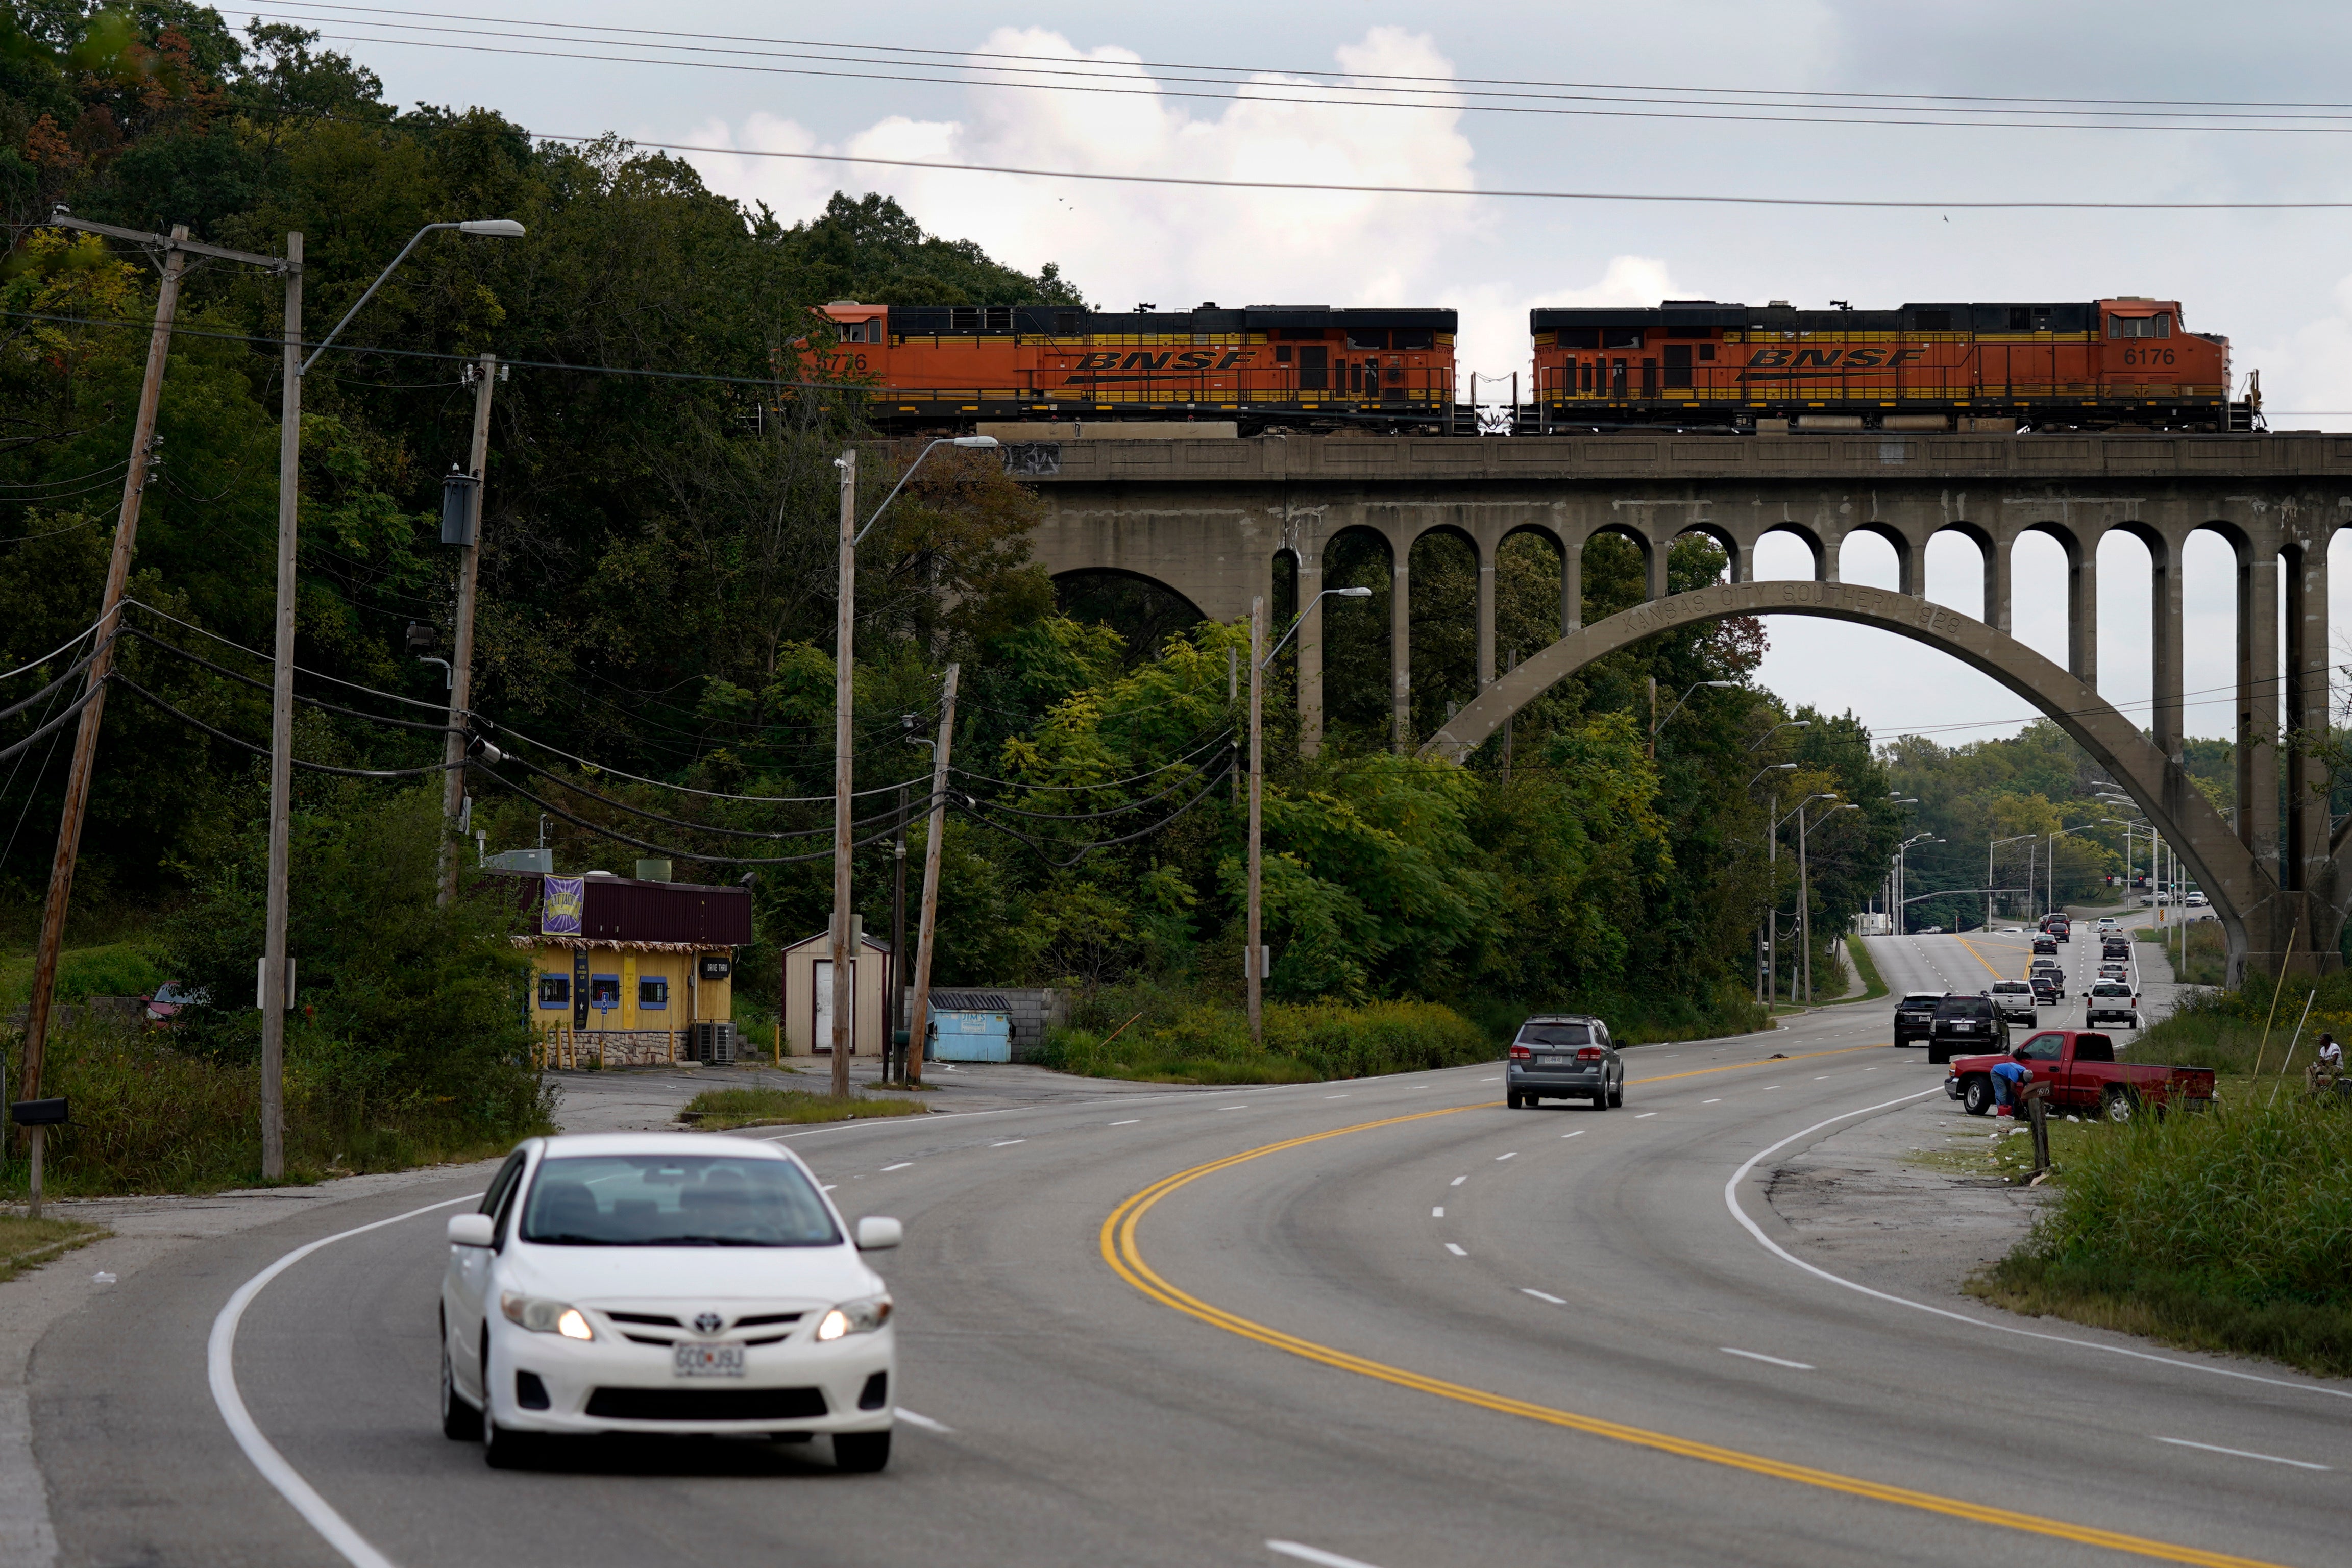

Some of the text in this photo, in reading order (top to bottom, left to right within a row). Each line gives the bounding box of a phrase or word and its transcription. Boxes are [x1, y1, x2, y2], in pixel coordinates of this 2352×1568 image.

[1437, 346, 1451, 354] 5776
[1538, 346, 1552, 355] 6176
[1746, 348, 1928, 367] BNSF
[2124, 348, 2175, 365] 6176
[1074, 351, 1258, 370] BNSF
[1622, 585, 1961, 634] KANSAS CITY SOUTHERN 1928
[707, 964, 728, 972] DRIVE THRU
